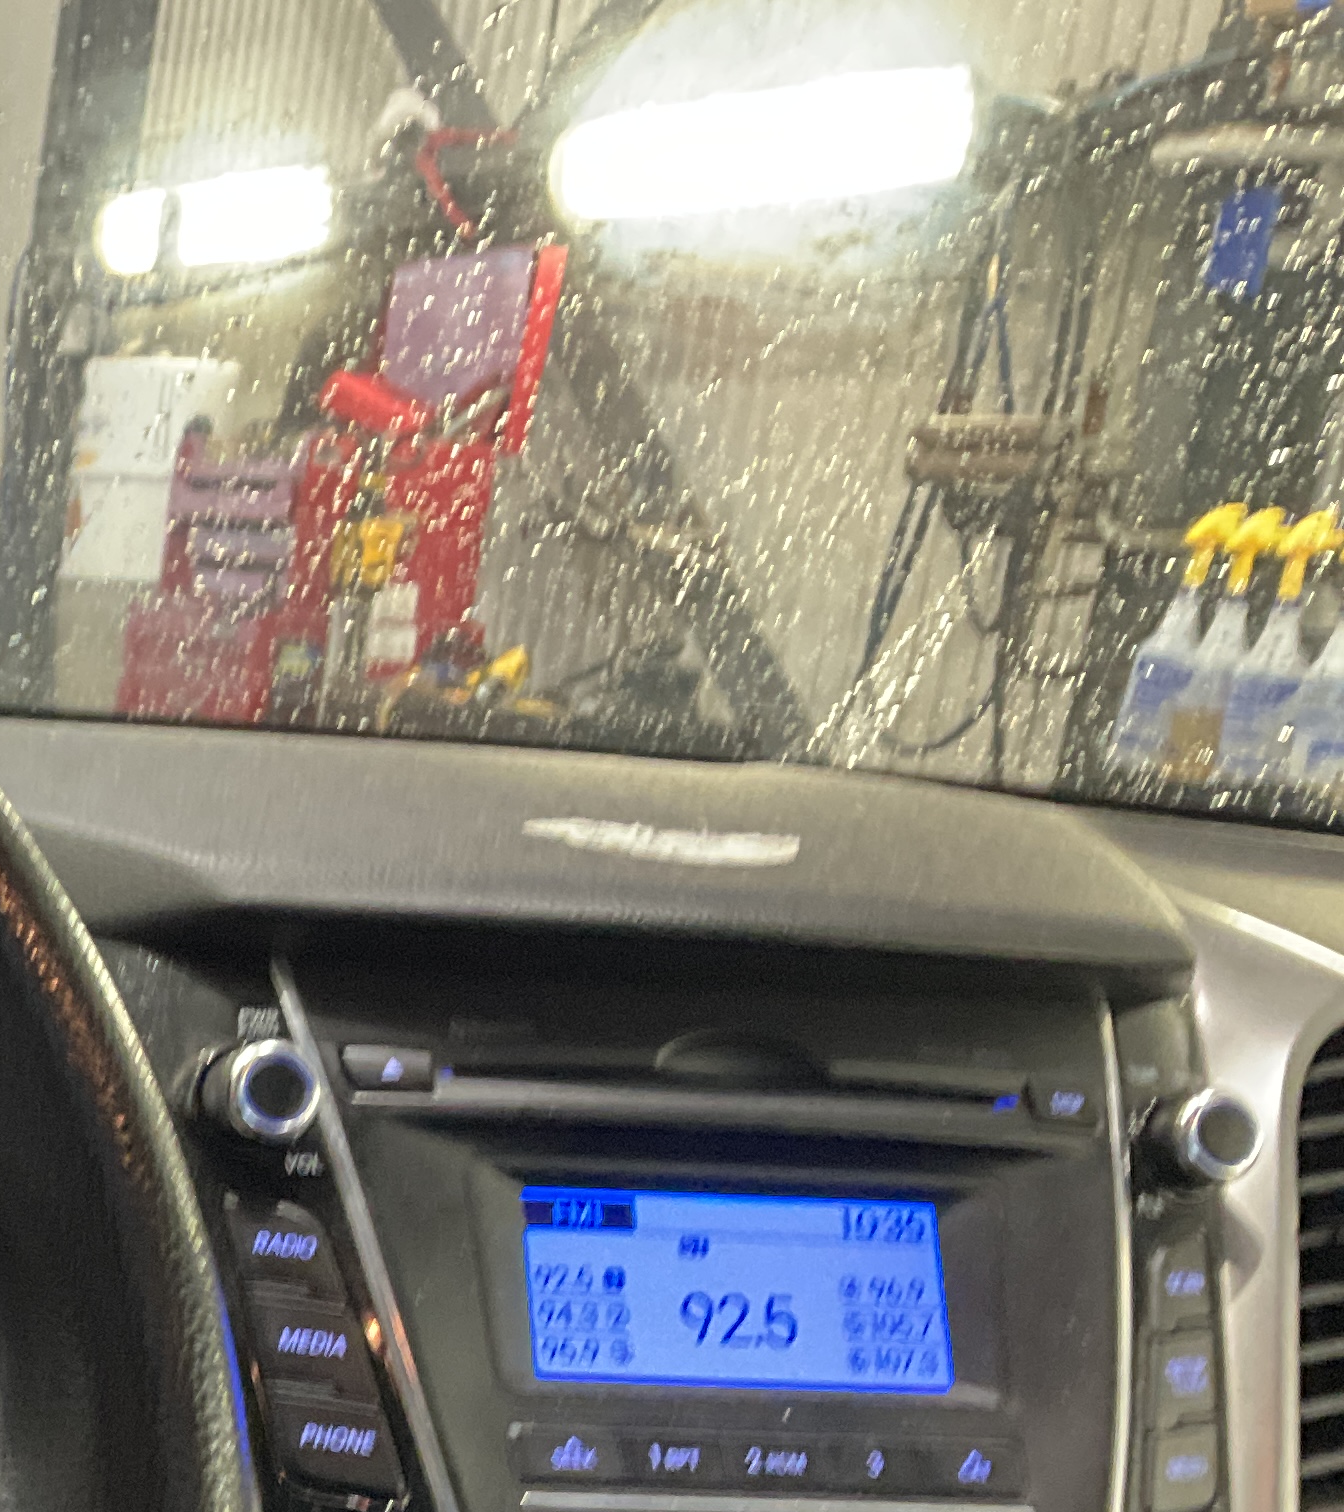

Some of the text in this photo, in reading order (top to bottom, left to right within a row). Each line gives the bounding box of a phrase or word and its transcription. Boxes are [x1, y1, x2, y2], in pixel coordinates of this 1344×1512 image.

[251, 1228, 318, 1262] RADIO
[679, 1290, 799, 1351] 92.5
[277, 1324, 348, 1359] MEDIA
[298, 1421, 376, 1457] PHONE
